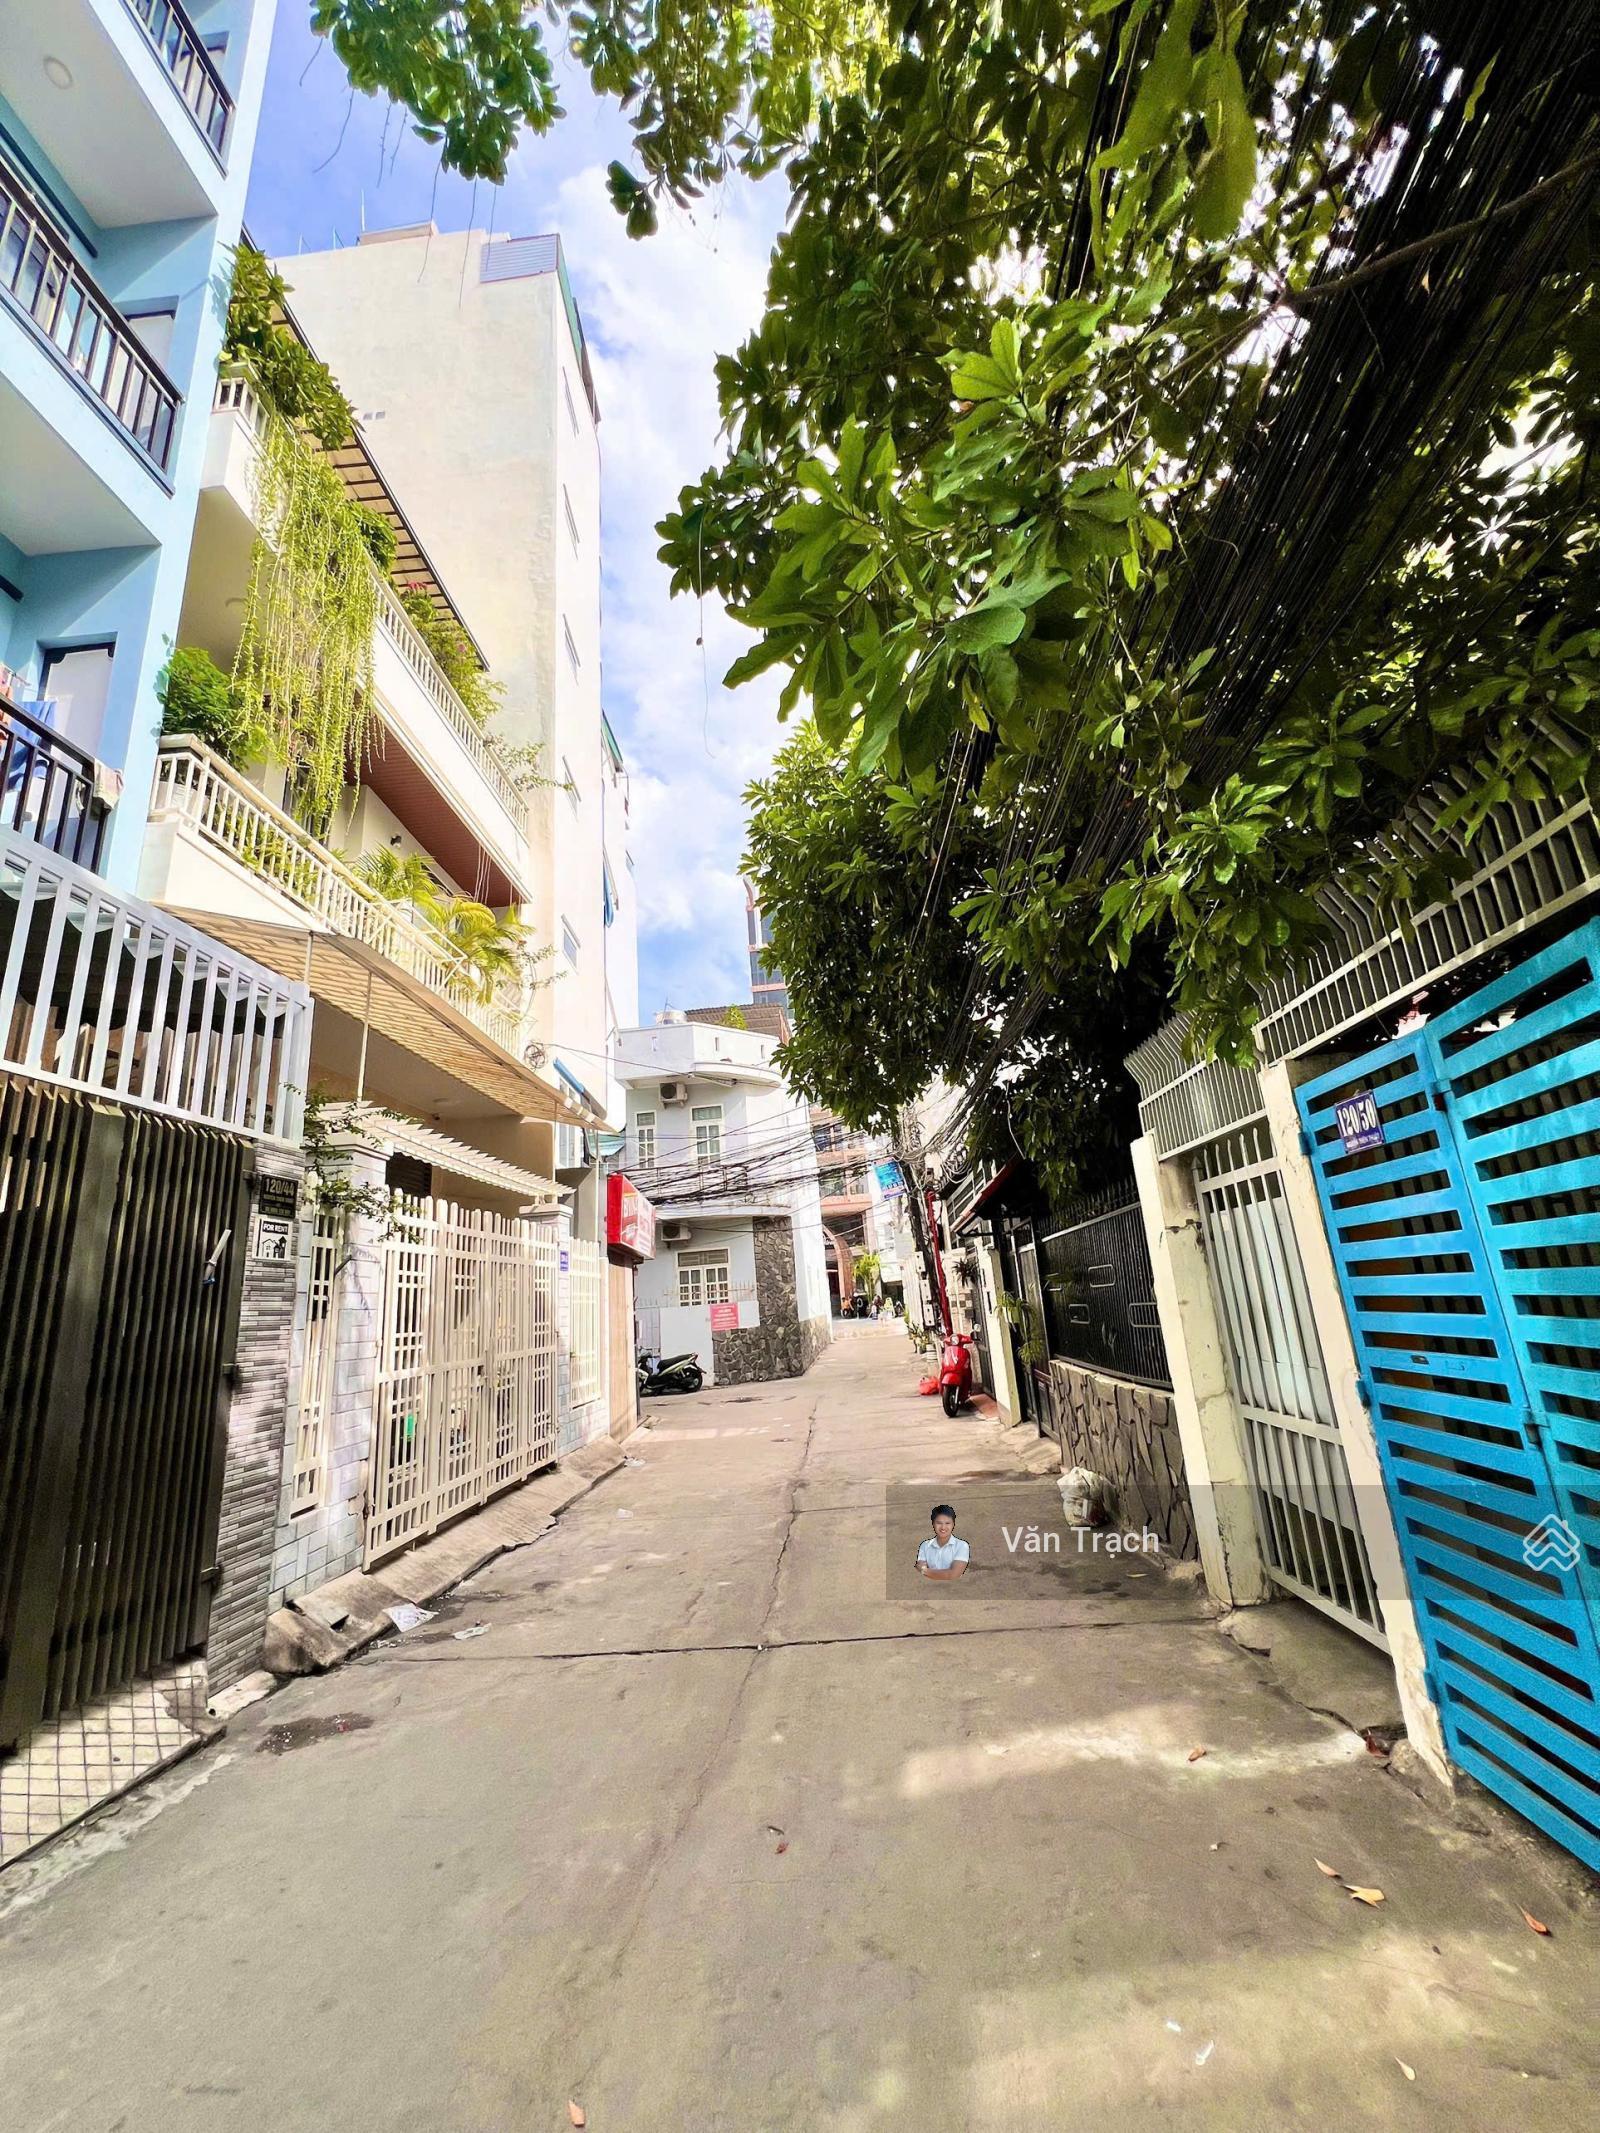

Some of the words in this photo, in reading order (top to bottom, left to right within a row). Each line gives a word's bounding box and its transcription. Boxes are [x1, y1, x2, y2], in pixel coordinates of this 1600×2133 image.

[1337, 1098, 1376, 1137] 120/50
[265, 1178, 295, 1196] 120/44
[263, 1223, 275, 1231] FOR
[275, 1225, 288, 1233] RENT
